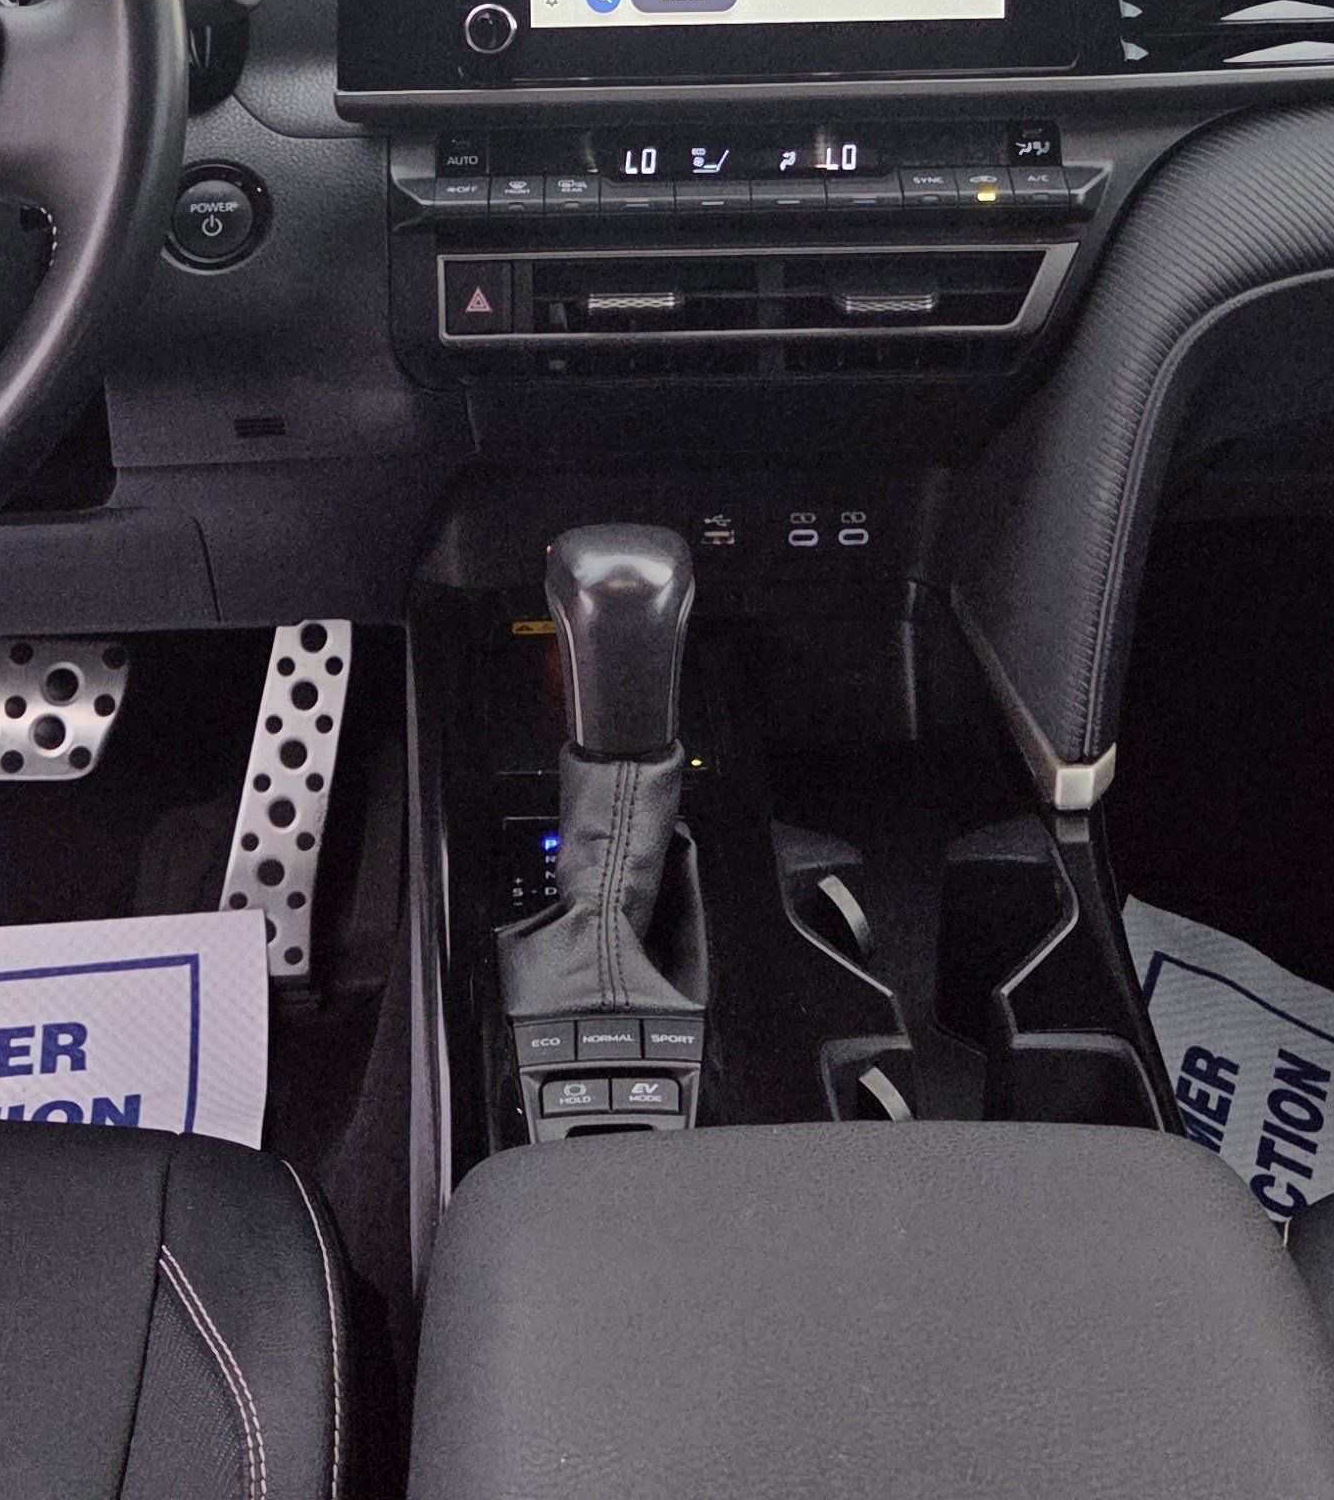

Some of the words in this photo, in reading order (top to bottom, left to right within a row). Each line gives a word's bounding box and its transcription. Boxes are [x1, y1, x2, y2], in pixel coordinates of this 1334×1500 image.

[446, 154, 479, 167] AUTO
[913, 176, 944, 185] SYNC
[1027, 173, 1050, 184] A/C
[190, 202, 234, 214] POWER
[531, 1037, 561, 1048] ECO
[582, 1033, 634, 1045] NORMAL
[650, 1033, 695, 1045] SPORT
[631, 1082, 660, 1094] EV
[559, 1095, 592, 1105] HOLD
[628, 1094, 662, 1103] MODE
[1249, 1048, 1332, 1219] CTION
